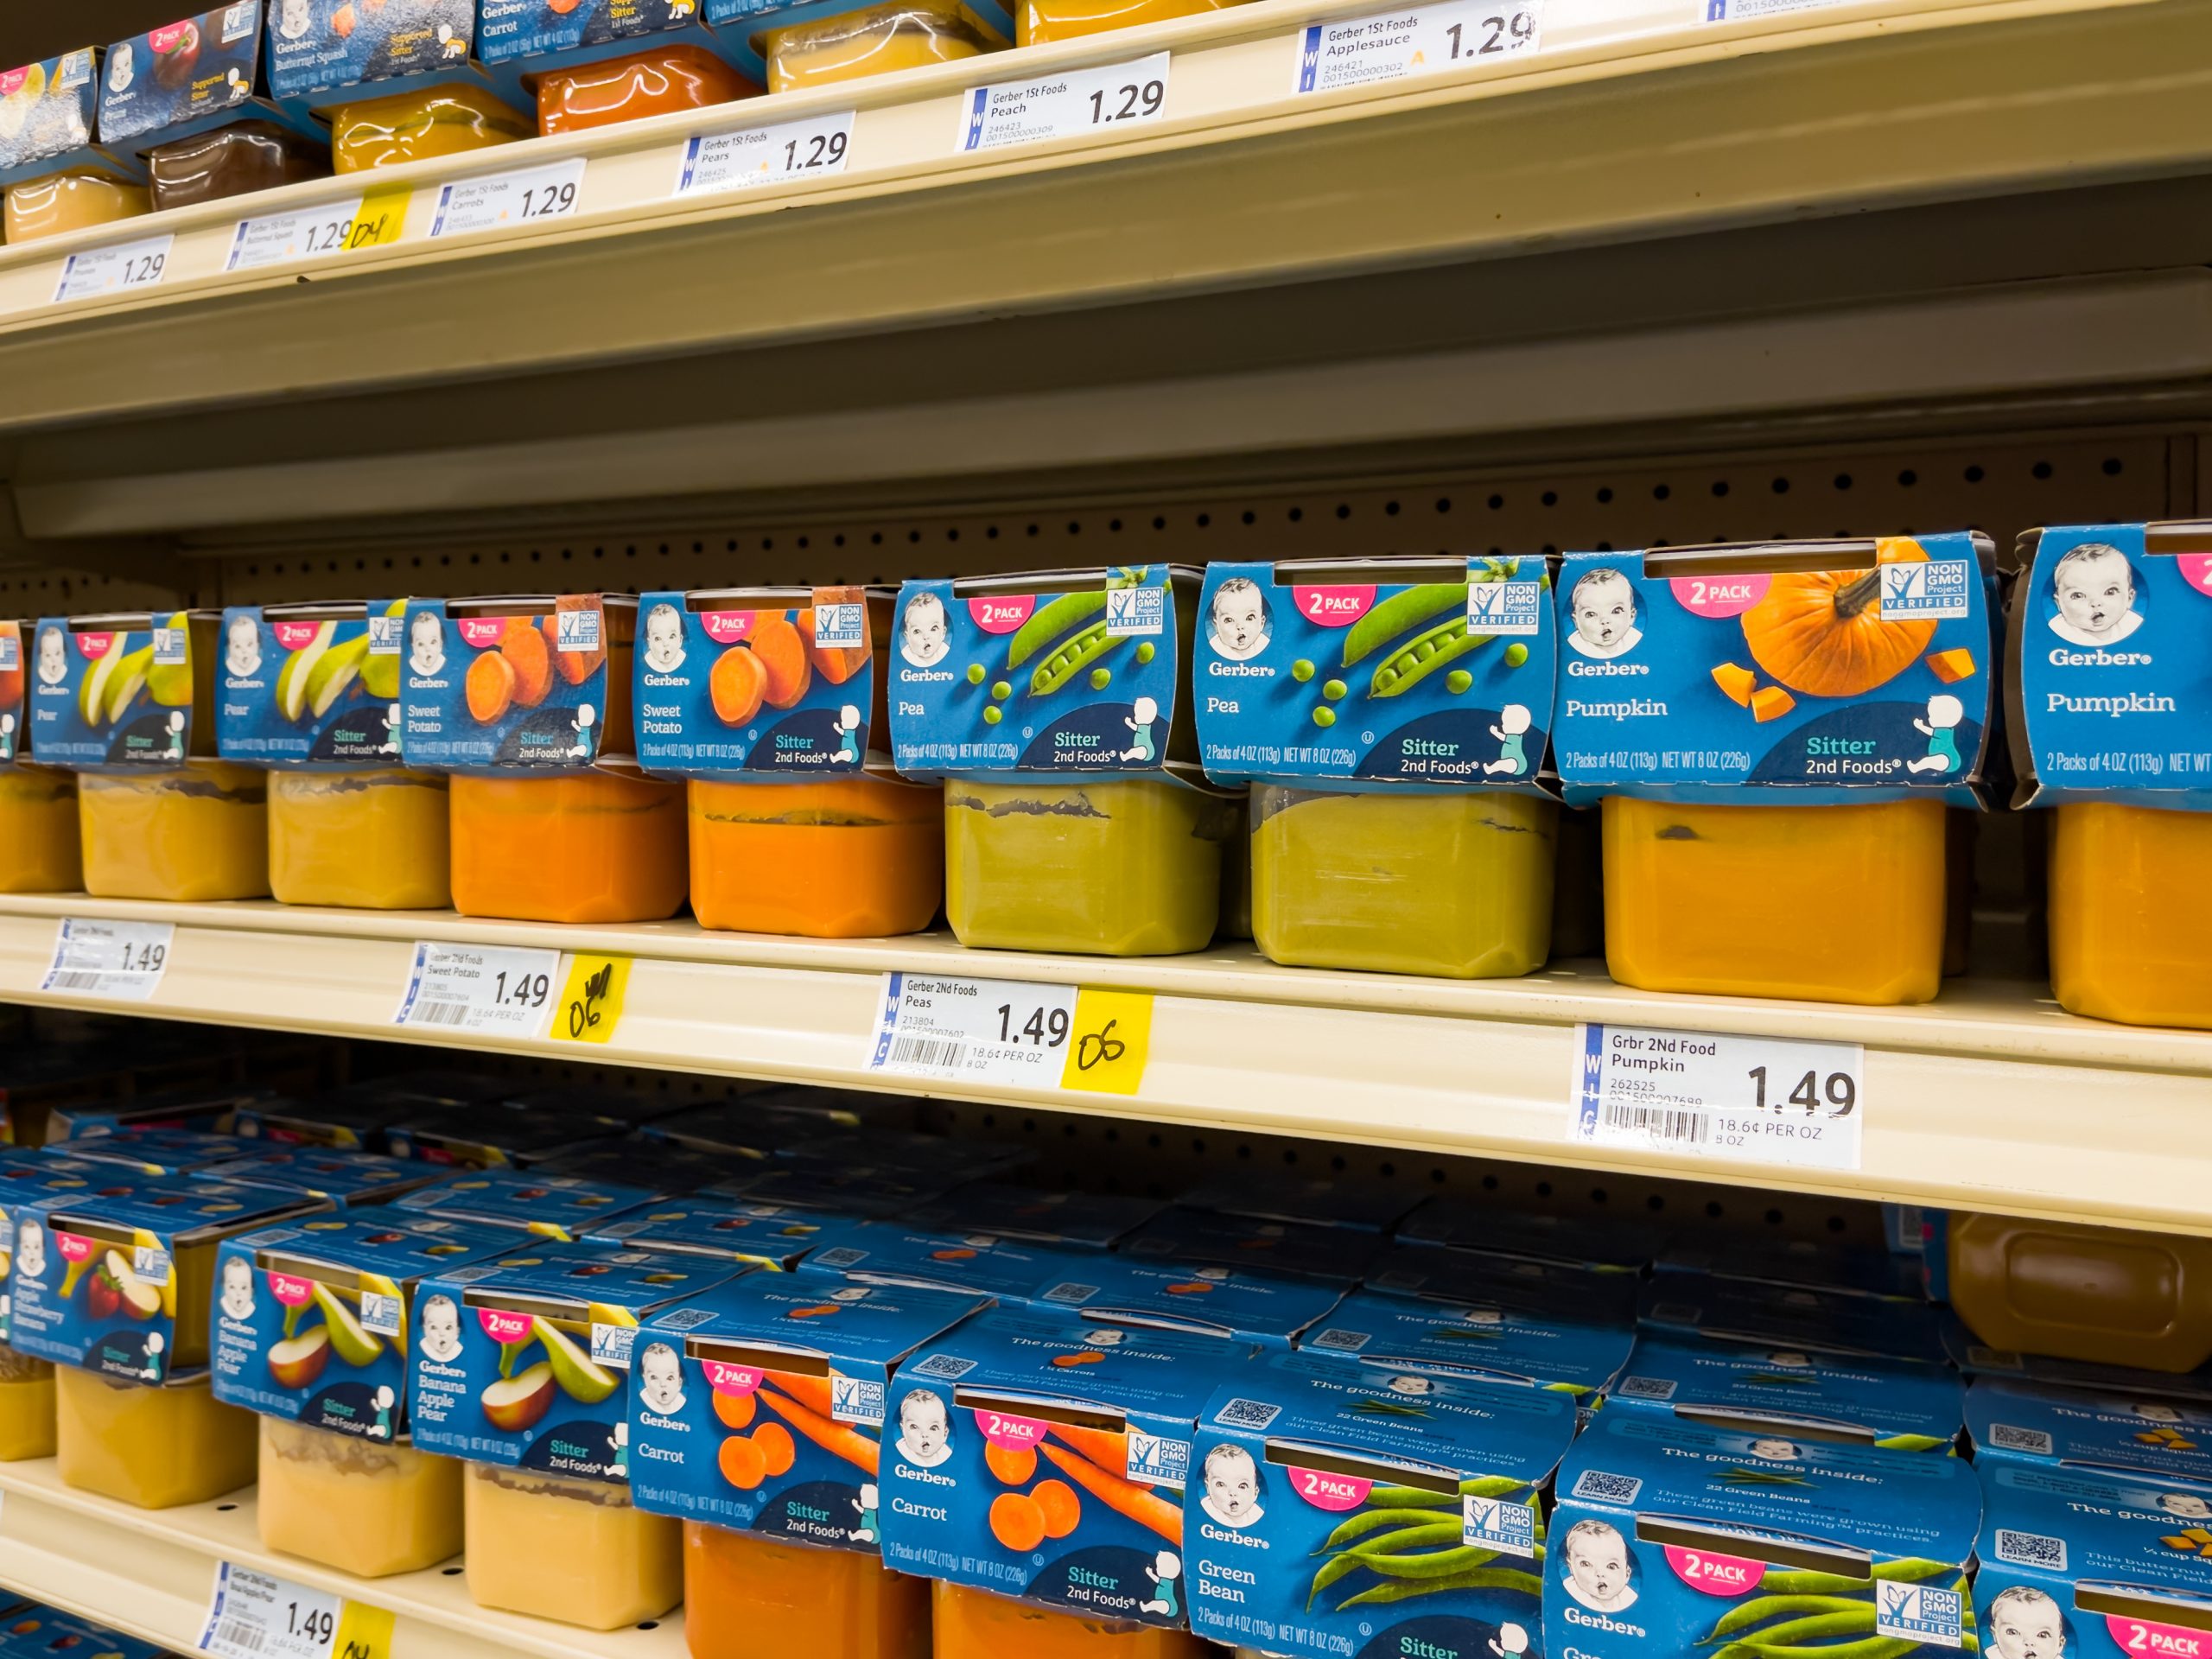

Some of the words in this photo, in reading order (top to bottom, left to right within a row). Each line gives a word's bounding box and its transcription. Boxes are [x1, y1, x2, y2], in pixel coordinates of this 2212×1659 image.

[611, 5, 637, 19] Sitter
[483, 20, 518, 37] Carrot
[1328, 27, 1364, 41] Gerber
[1386, 16, 1418, 32] Foods
[1446, 11, 1536, 60] 1.29
[156, 33, 162, 47] 2
[1326, 33, 1410, 57] Applesauce
[1324, 60, 1363, 74] 246421
[993, 92, 1022, 104] Gerber
[1041, 83, 1067, 97] Foods
[1090, 79, 1164, 124] 1.29
[991, 104, 1027, 118] Peach
[704, 140, 729, 150] Gerber
[745, 131, 767, 143] Foods
[702, 152, 729, 163] Pears
[785, 131, 848, 171] 1.29
[522, 182, 575, 218] 1.29
[306, 219, 354, 252] 1.29
[124, 251, 166, 284] 1.29
[1928, 563, 1962, 575] NON
[1928, 574, 1963, 585] GMO
[1506, 585, 1535, 595] NON
[1691, 582, 1706, 604] 2
[1709, 585, 1751, 599] PACK
[1927, 585, 1962, 594] Project
[1310, 593, 1323, 613] 2
[1325, 597, 1360, 610] PACK
[1506, 594, 1535, 605] GMO
[1506, 604, 1535, 613] Project
[1886, 597, 1963, 609] VERIFIED
[841, 614, 860, 623] GMO
[982, 604, 993, 623] 2
[995, 607, 1022, 619] PACK
[711, 615, 721, 632] 2
[721, 618, 745, 630] PACK
[283, 626, 291, 641] 2
[292, 628, 311, 638] PACK
[817, 631, 861, 639] VERIFIED
[408, 705, 441, 717] Sweet
[643, 703, 681, 717] Sweet
[899, 702, 925, 715] Pea
[1207, 697, 1239, 713] Pea
[1566, 698, 1668, 721] Pumpkin
[2046, 692, 2176, 717] Pumpkin
[334, 729, 366, 741] Sitter
[408, 721, 442, 733] Potato
[643, 721, 683, 734] Potato
[776, 734, 814, 749] Sitter
[1402, 739, 1459, 756] Sitter
[1807, 736, 1876, 755] Sitter
[775, 752, 792, 763] 2nd
[1206, 745, 1211, 759] 2
[1212, 745, 1232, 760] Packs
[1233, 747, 1240, 760] of
[1241, 747, 1246, 760] 4
[1246, 747, 1257, 761] OZ
[1257, 747, 1281, 764] (113g)
[1284, 747, 1299, 762] NET
[1300, 748, 1313, 763] WT
[1313, 748, 1319, 763] 8
[1320, 748, 1331, 764] OZ
[1332, 749, 1356, 767] (226g)
[1401, 760, 1426, 772] 2nd
[1806, 760, 1837, 774] 2nd
[123, 942, 166, 971] 1.49
[428, 965, 451, 976] Sweet
[453, 967, 480, 979] Potato
[496, 971, 549, 1007] 1.49
[907, 980, 934, 993] Gerber
[936, 982, 951, 995] 2Nd
[953, 983, 977, 996] Foods
[906, 995, 931, 1008] Peas
[903, 1016, 934, 1027] 213804
[998, 1003, 1069, 1047] 1.49
[1612, 1035, 1644, 1051] Grbr
[1648, 1038, 1676, 1052] 2Nd
[1681, 1039, 1716, 1056] Food
[975, 1059, 988, 1070] OZ
[1003, 1051, 1024, 1061] PER
[1026, 1052, 1042, 1064] OZ
[1611, 1054, 1685, 1073] Pumpkin
[1611, 1077, 1656, 1091] 262525
[1748, 1065, 1856, 1120] 1.49
[1765, 1122, 1795, 1137] PER
[1800, 1126, 1822, 1140] OZ
[1726, 1135, 1745, 1147] OZ
[418, 1375, 467, 1395] Banana
[417, 1390, 454, 1408] Apple
[1311, 1379, 1343, 1390] The
[1346, 1386, 1431, 1406] goodness
[1435, 1402, 1496, 1420] inside:
[417, 1405, 448, 1422] Pear
[988, 1415, 1001, 1435] 2
[1002, 1422, 1034, 1438] PACK
[1353, 1414, 1386, 1426] Green
[1389, 1421, 1424, 1433] Beans
[550, 1440, 589, 1459] Sitter
[639, 1442, 684, 1465] Carrot
[1662, 1447, 1701, 1459] The
[1705, 1454, 1806, 1472] goodness
[1811, 1467, 1885, 1485] inside:
[892, 1497, 948, 1522] Carrot
[1467, 1526, 1530, 1547] VERIFIED
[1198, 1559, 1256, 1586] Green
[1684, 1554, 1701, 1578] 2
[1704, 1563, 1746, 1582] PACK
[1068, 1566, 1119, 1591] Sitter
[1198, 1580, 1245, 1604] Bean
[288, 1602, 334, 1644] 1.49
